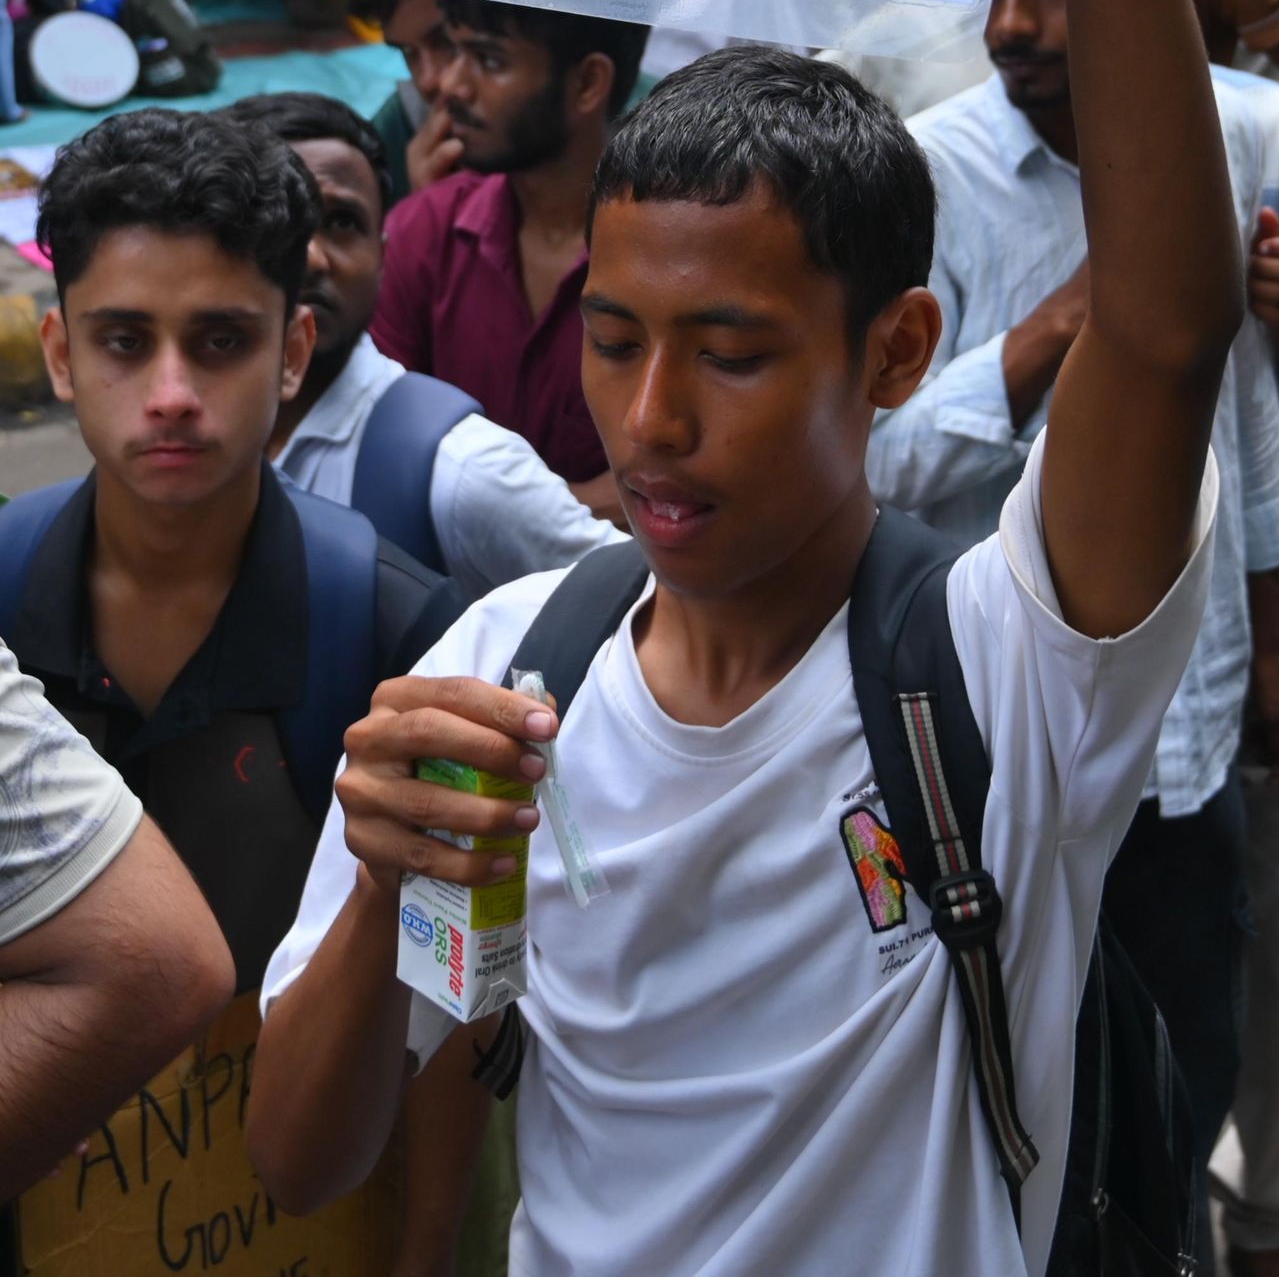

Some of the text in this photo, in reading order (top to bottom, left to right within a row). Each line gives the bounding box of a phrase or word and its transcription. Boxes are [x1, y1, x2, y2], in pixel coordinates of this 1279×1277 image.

[434, 917, 447, 966] ORS
[447, 923, 464, 997] prolyte
[475, 967, 490, 978] Oral
[482, 952, 498, 963] Salts
